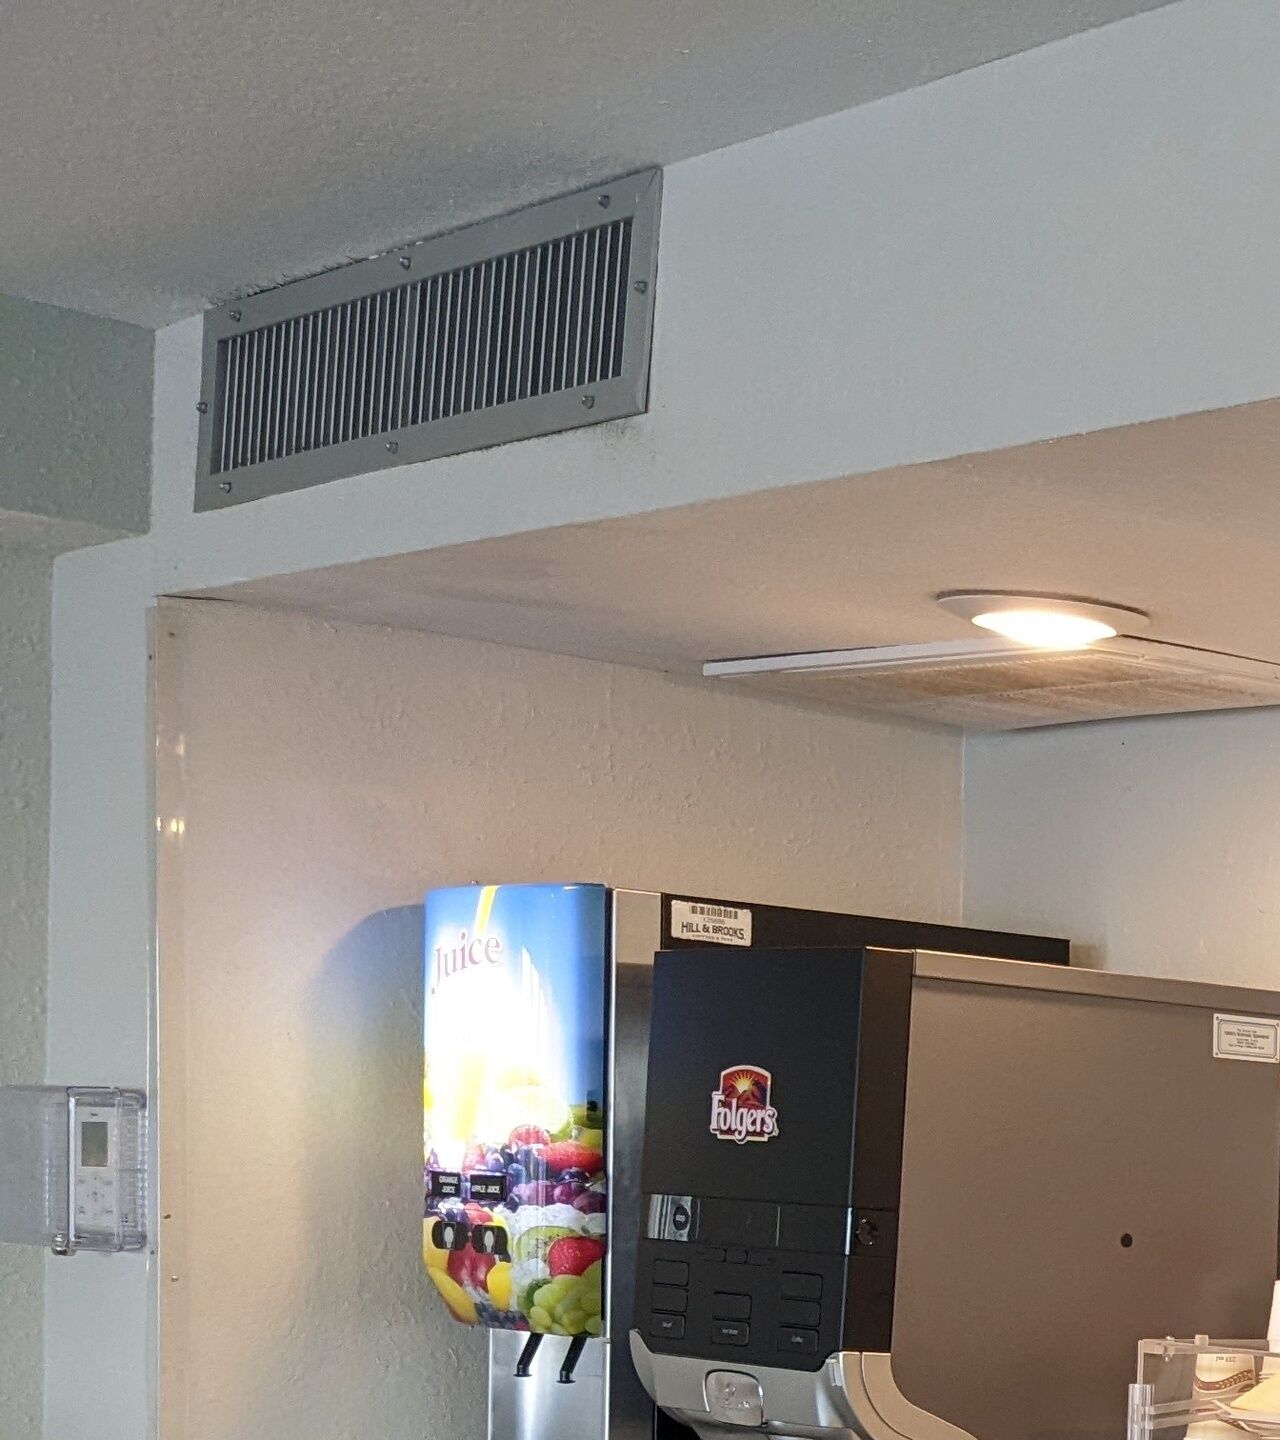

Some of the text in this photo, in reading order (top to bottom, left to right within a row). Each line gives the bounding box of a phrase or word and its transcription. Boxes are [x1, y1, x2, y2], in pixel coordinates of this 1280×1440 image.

[681, 921, 701, 933] HILL
[702, 924, 710, 933] &
[712, 925, 746, 940] BROOKS
[431, 931, 504, 996] Juice
[711, 1094, 775, 1140] Folgers
